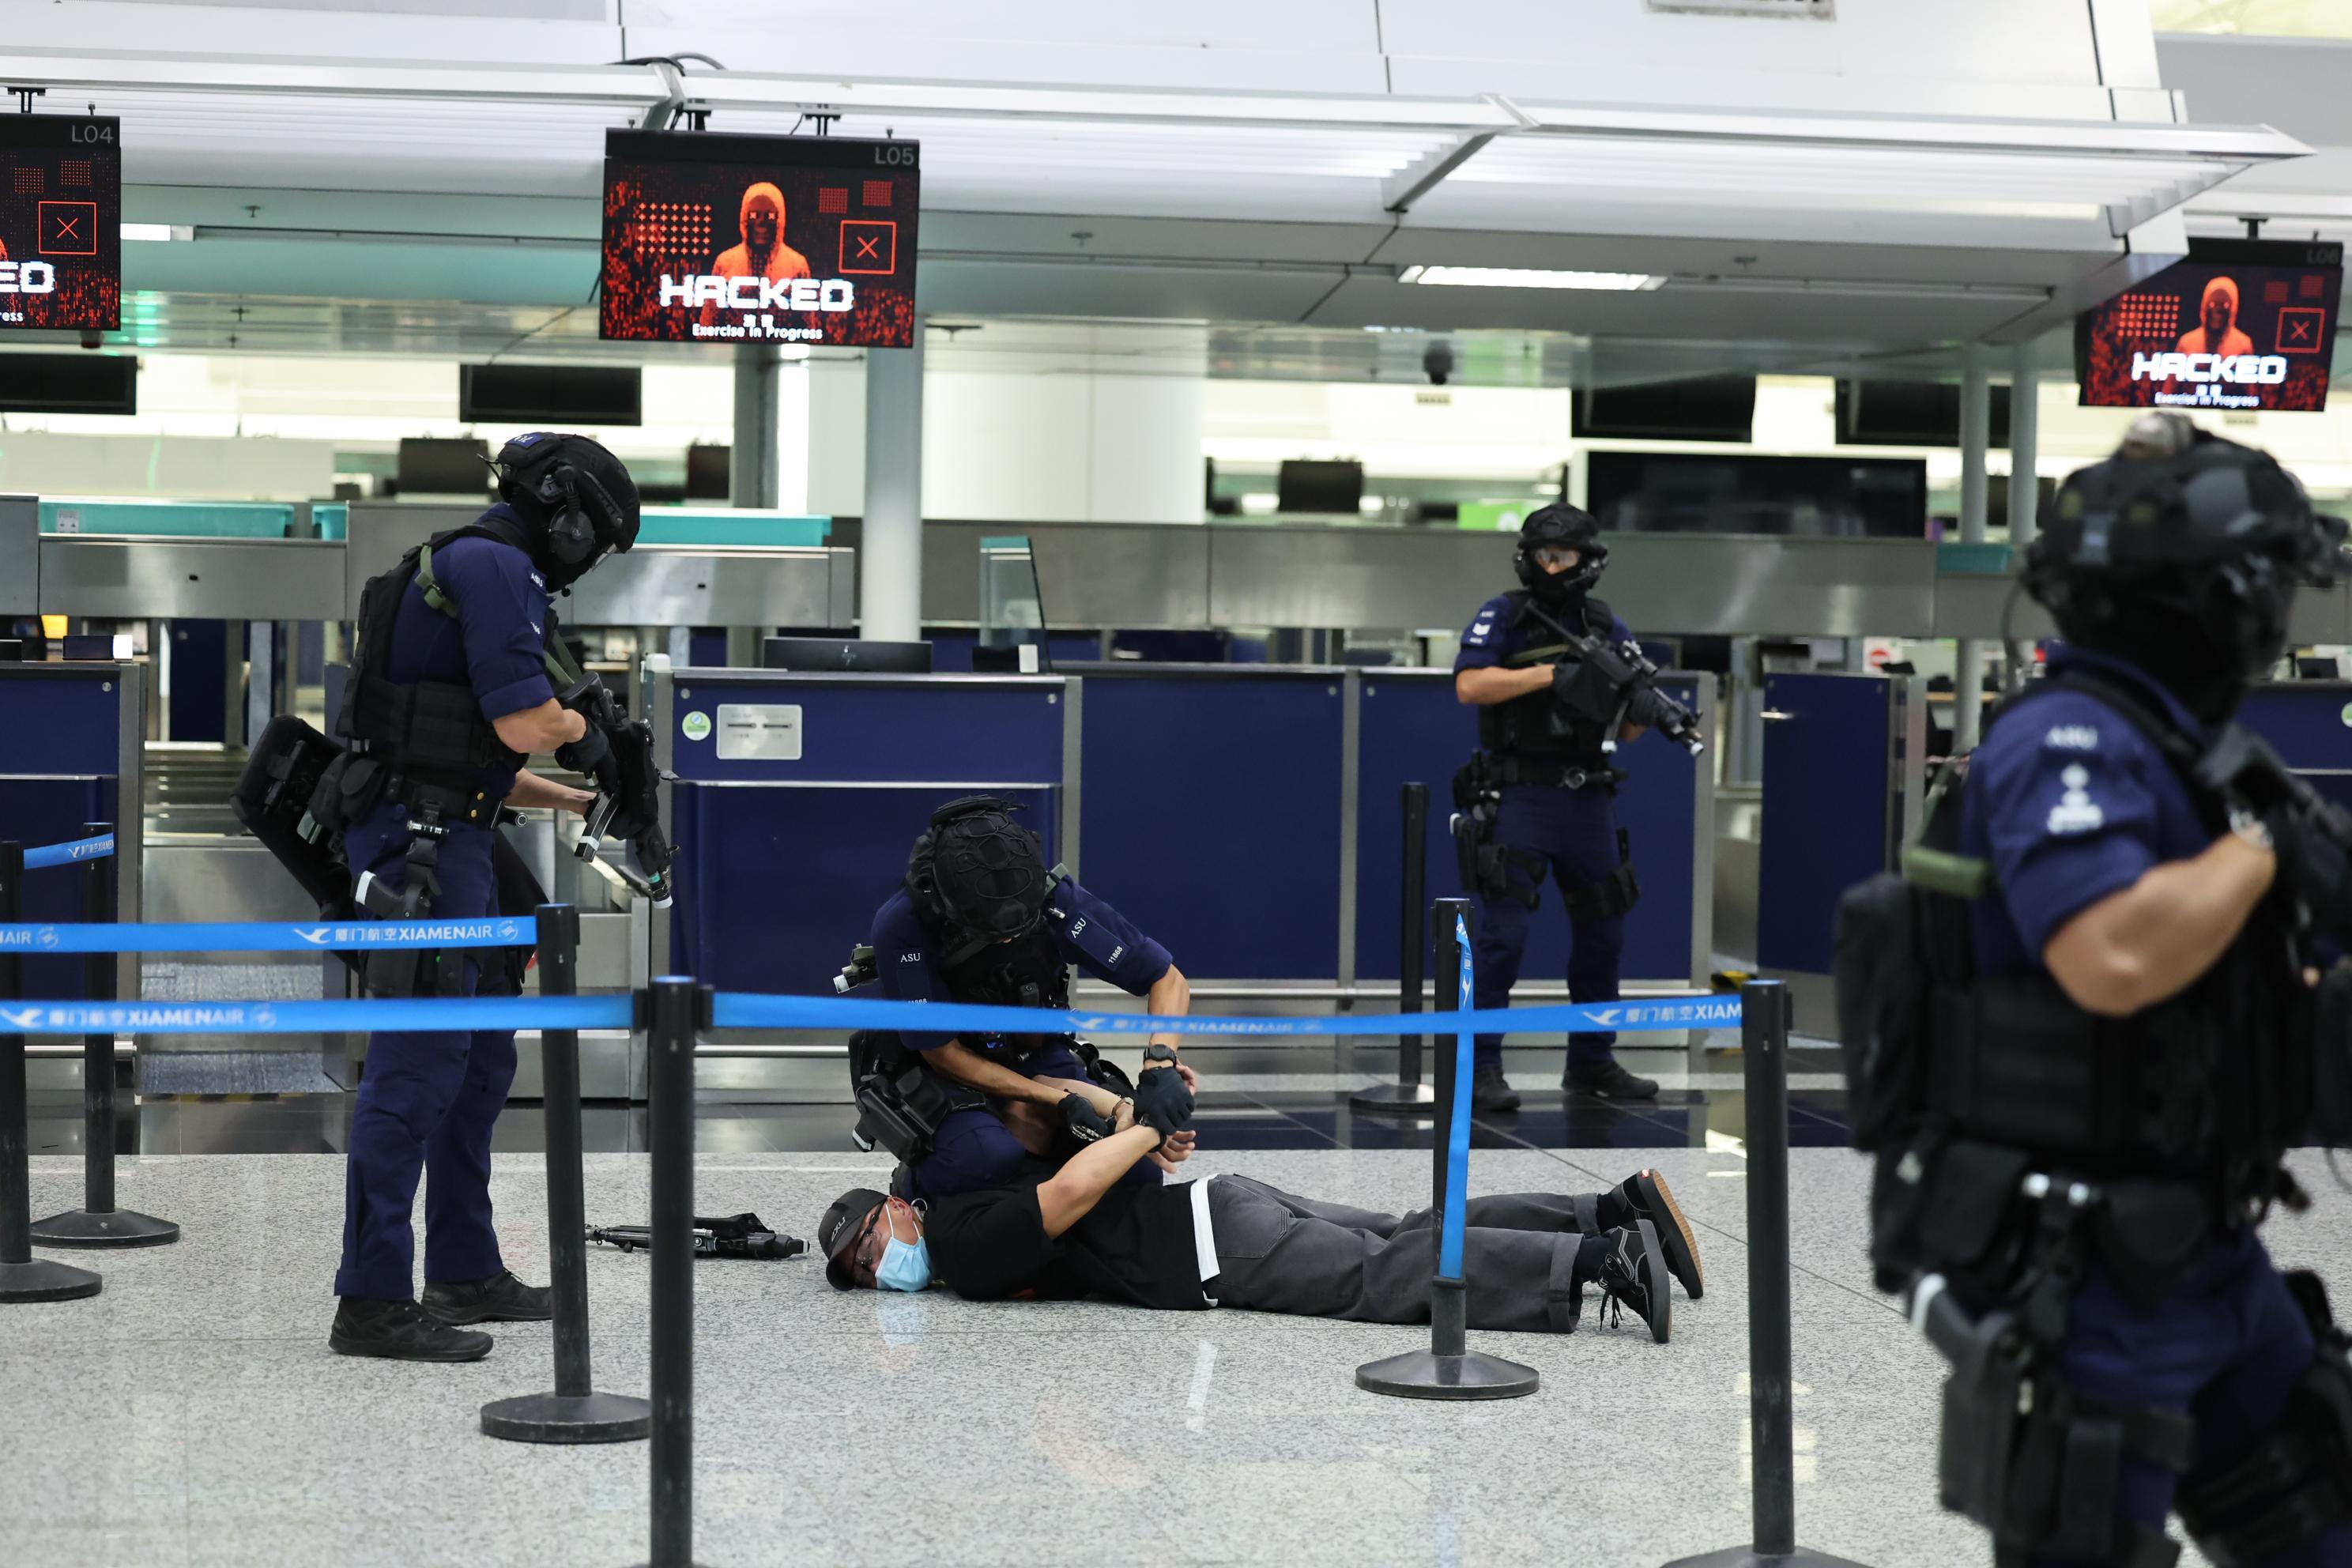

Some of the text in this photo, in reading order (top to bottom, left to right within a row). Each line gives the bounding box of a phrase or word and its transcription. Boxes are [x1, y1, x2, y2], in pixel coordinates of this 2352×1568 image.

[72, 126, 113, 144] L04
[875, 145, 914, 166] L05
[659, 273, 855, 311] HACKED
[692, 323, 745, 337] Exercise
[766, 325, 823, 341] Progress
[2132, 352, 2287, 384] HACKED
[0, 930, 32, 945] AIR
[398, 925, 492, 941] XIAMENAIR
[1070, 918, 1087, 939] ASU
[900, 952, 922, 963] ASU
[1108, 945, 1123, 964] 11868
[127, 1008, 245, 1027] XIAMENAIR
